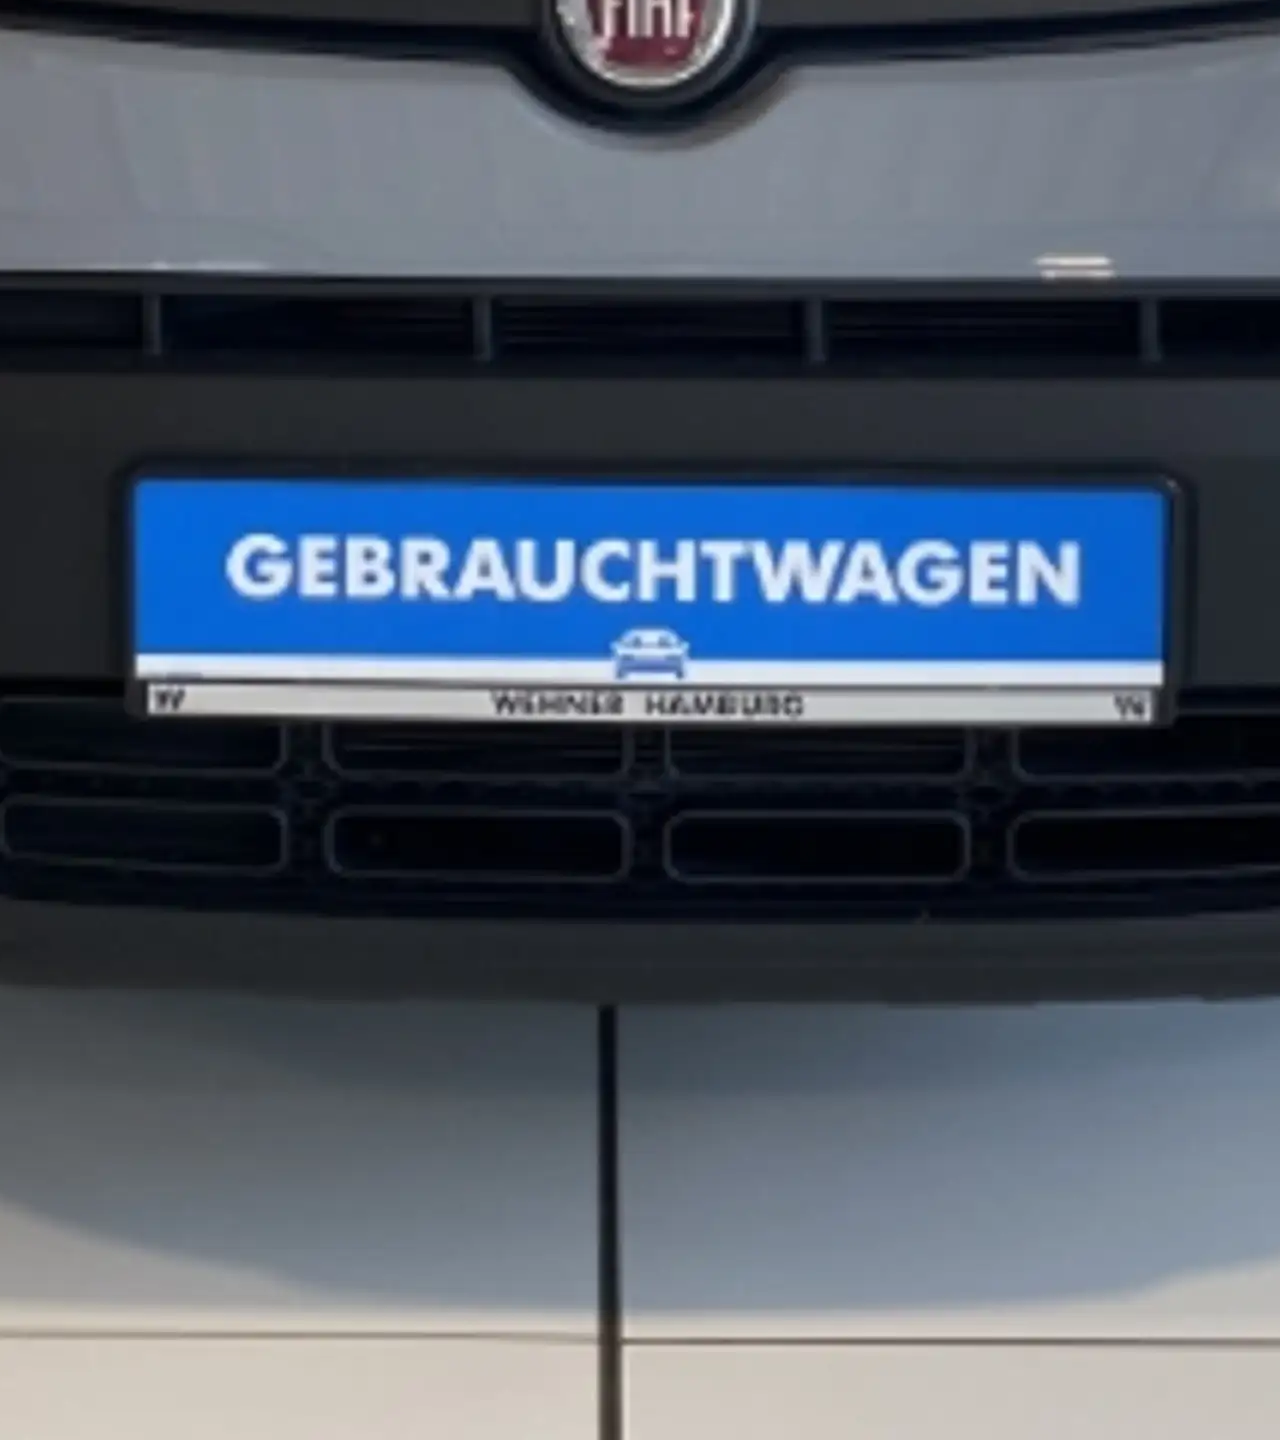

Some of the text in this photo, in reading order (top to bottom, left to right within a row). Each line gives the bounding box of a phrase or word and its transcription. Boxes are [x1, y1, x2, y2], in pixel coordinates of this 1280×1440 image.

[226, 533, 1080, 605] GEBRAUCHTWAGEN
[490, 689, 623, 715] WEHNER
[645, 691, 804, 717] HAMBURG
